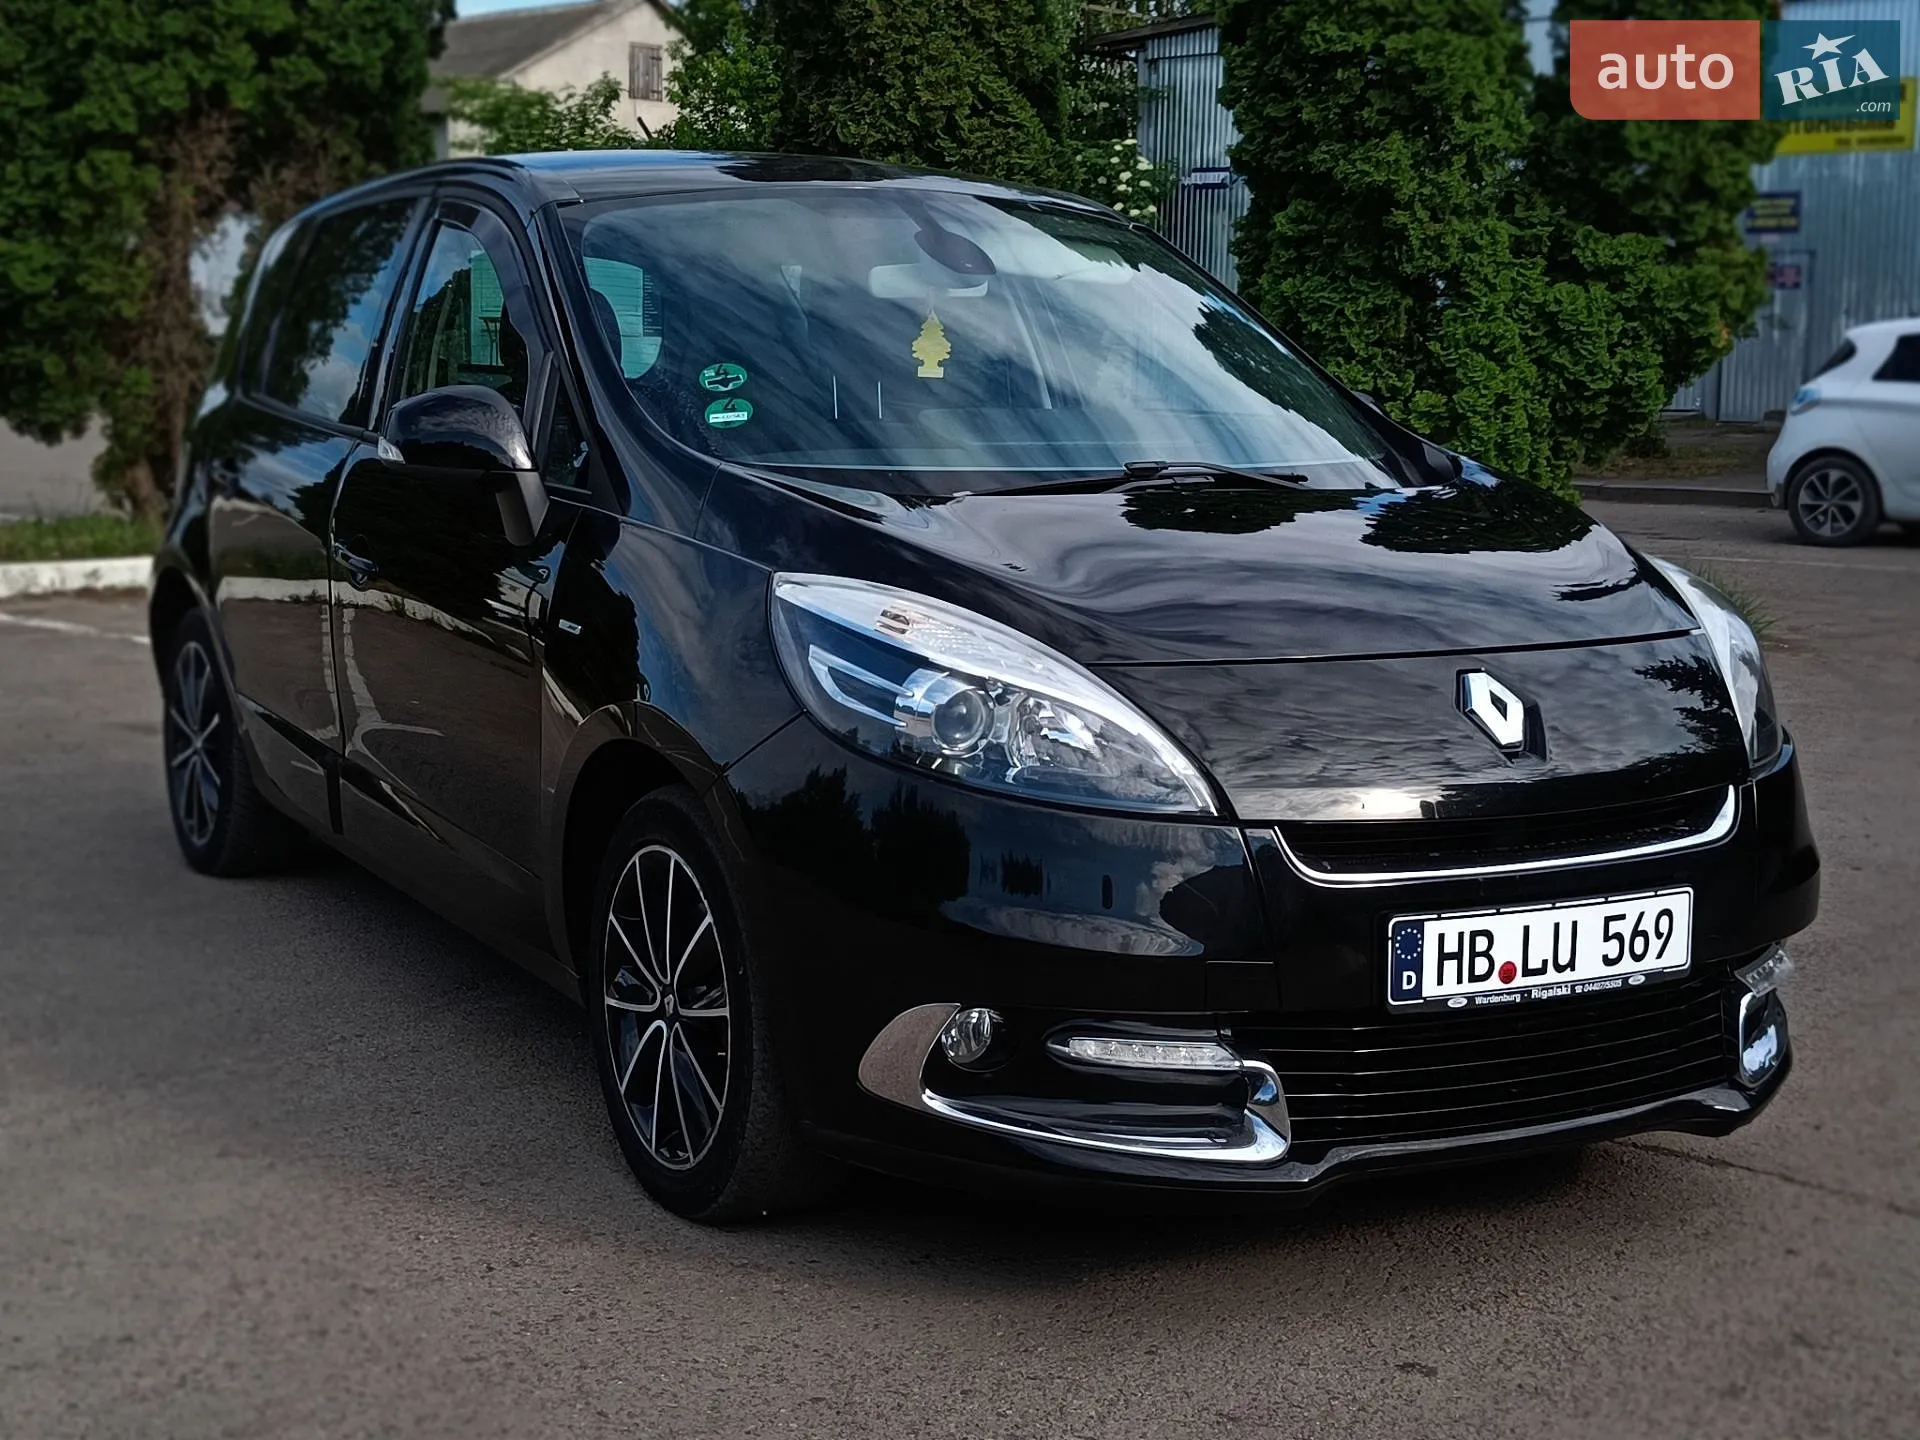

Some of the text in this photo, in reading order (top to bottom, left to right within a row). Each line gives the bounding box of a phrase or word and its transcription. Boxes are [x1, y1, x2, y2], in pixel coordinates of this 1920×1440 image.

[1436, 908, 1674, 987] HB LU 569
[1401, 971, 1417, 991] D
[1475, 993, 1521, 1006] Wardenburg
